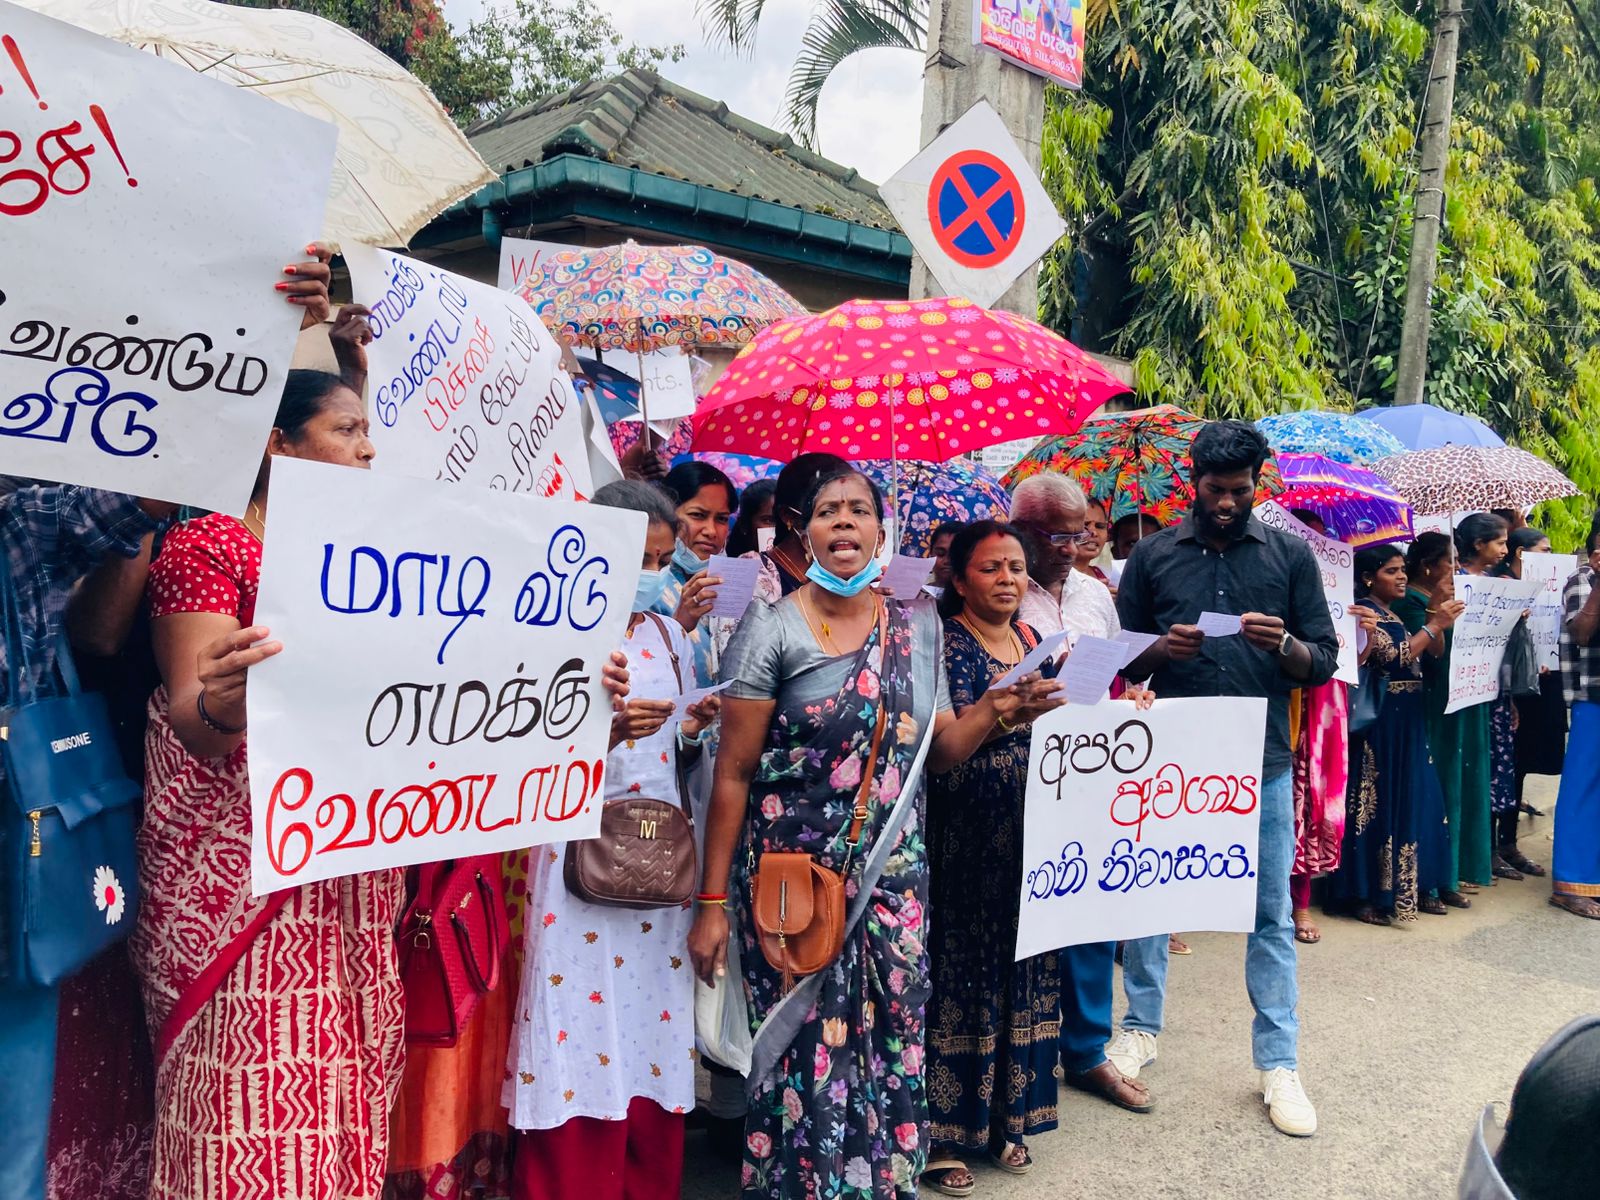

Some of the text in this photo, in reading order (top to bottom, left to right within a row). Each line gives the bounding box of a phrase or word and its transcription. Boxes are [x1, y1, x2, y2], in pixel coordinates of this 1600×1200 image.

[0, 315, 268, 397] வண்டும்
[320, 543, 491, 664] மாடி
[514, 524, 609, 631] வீடு
[366, 657, 590, 748] எமக்கு
[1039, 719, 1153, 800] අපට
[266, 744, 604, 877] வேண்டாம்!
[640, 820, 656, 839] M
